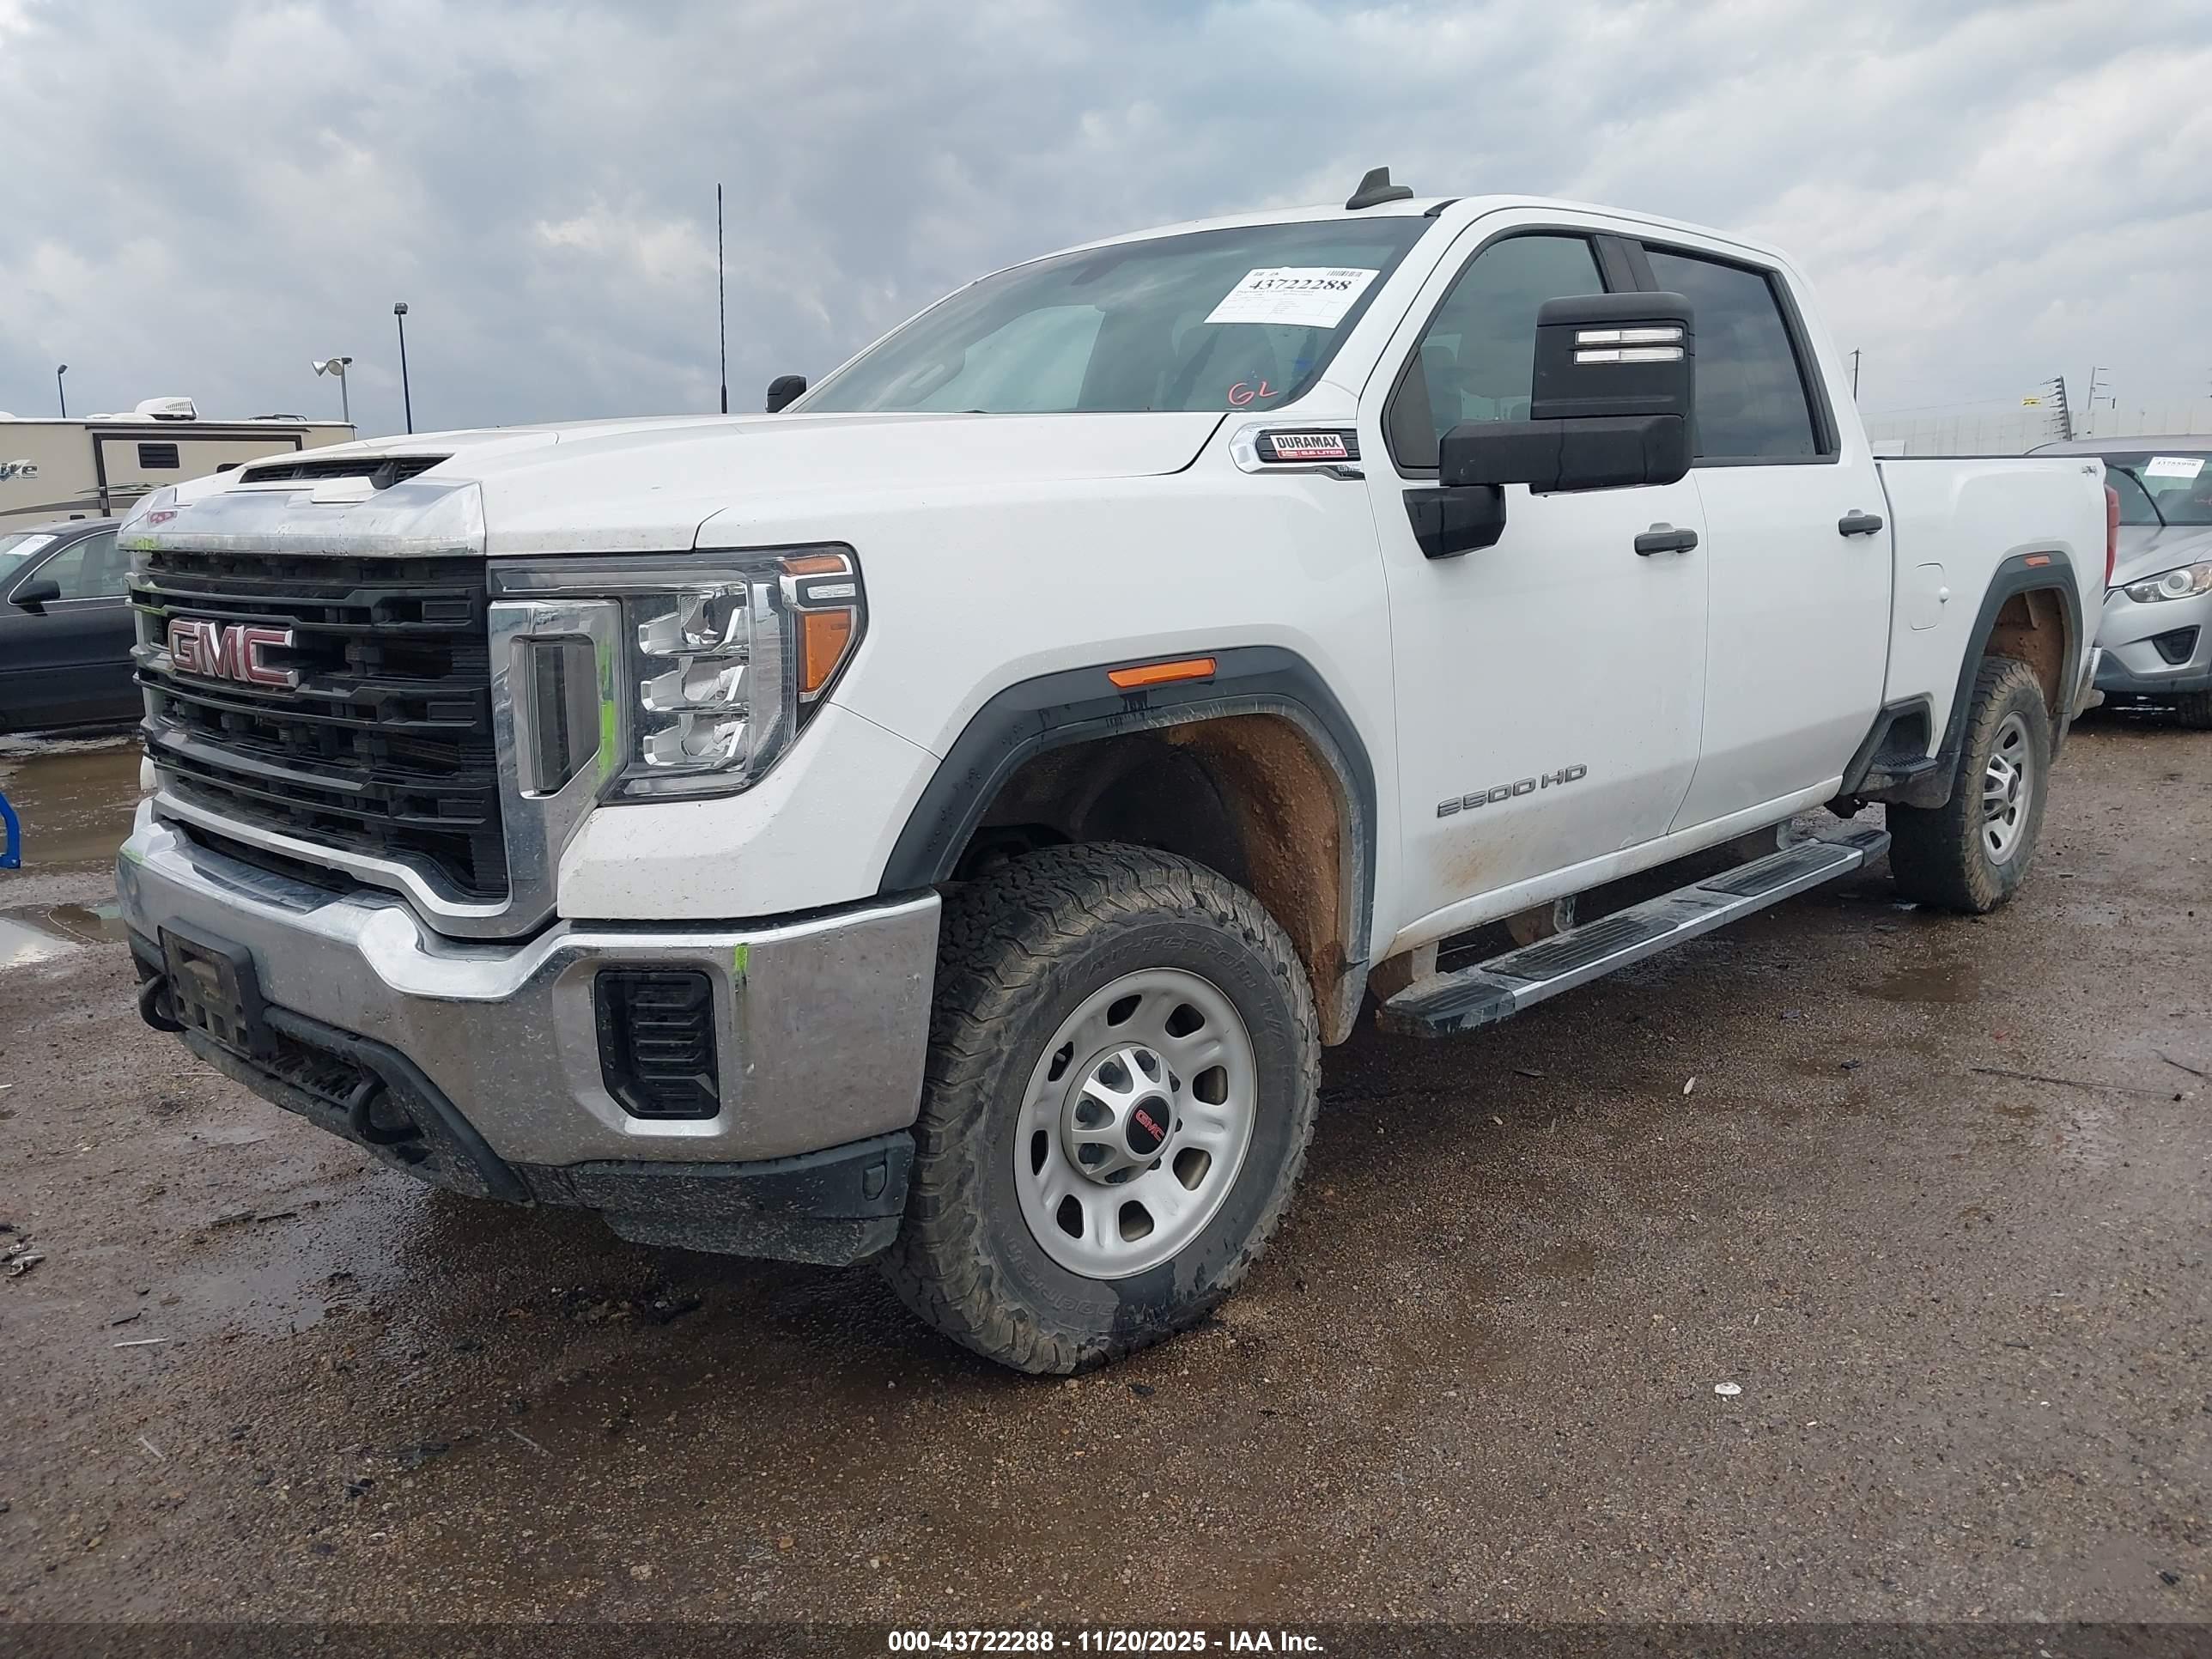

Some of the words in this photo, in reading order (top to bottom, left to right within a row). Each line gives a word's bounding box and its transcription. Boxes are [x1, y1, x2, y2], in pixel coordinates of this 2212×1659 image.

[1249, 278, 1352, 291] 43722288
[1275, 436, 1340, 449] DURAMAX
[167, 618, 300, 688] GMC
[1540, 763, 1588, 789] HD
[1135, 1109, 1165, 1143] GMC
